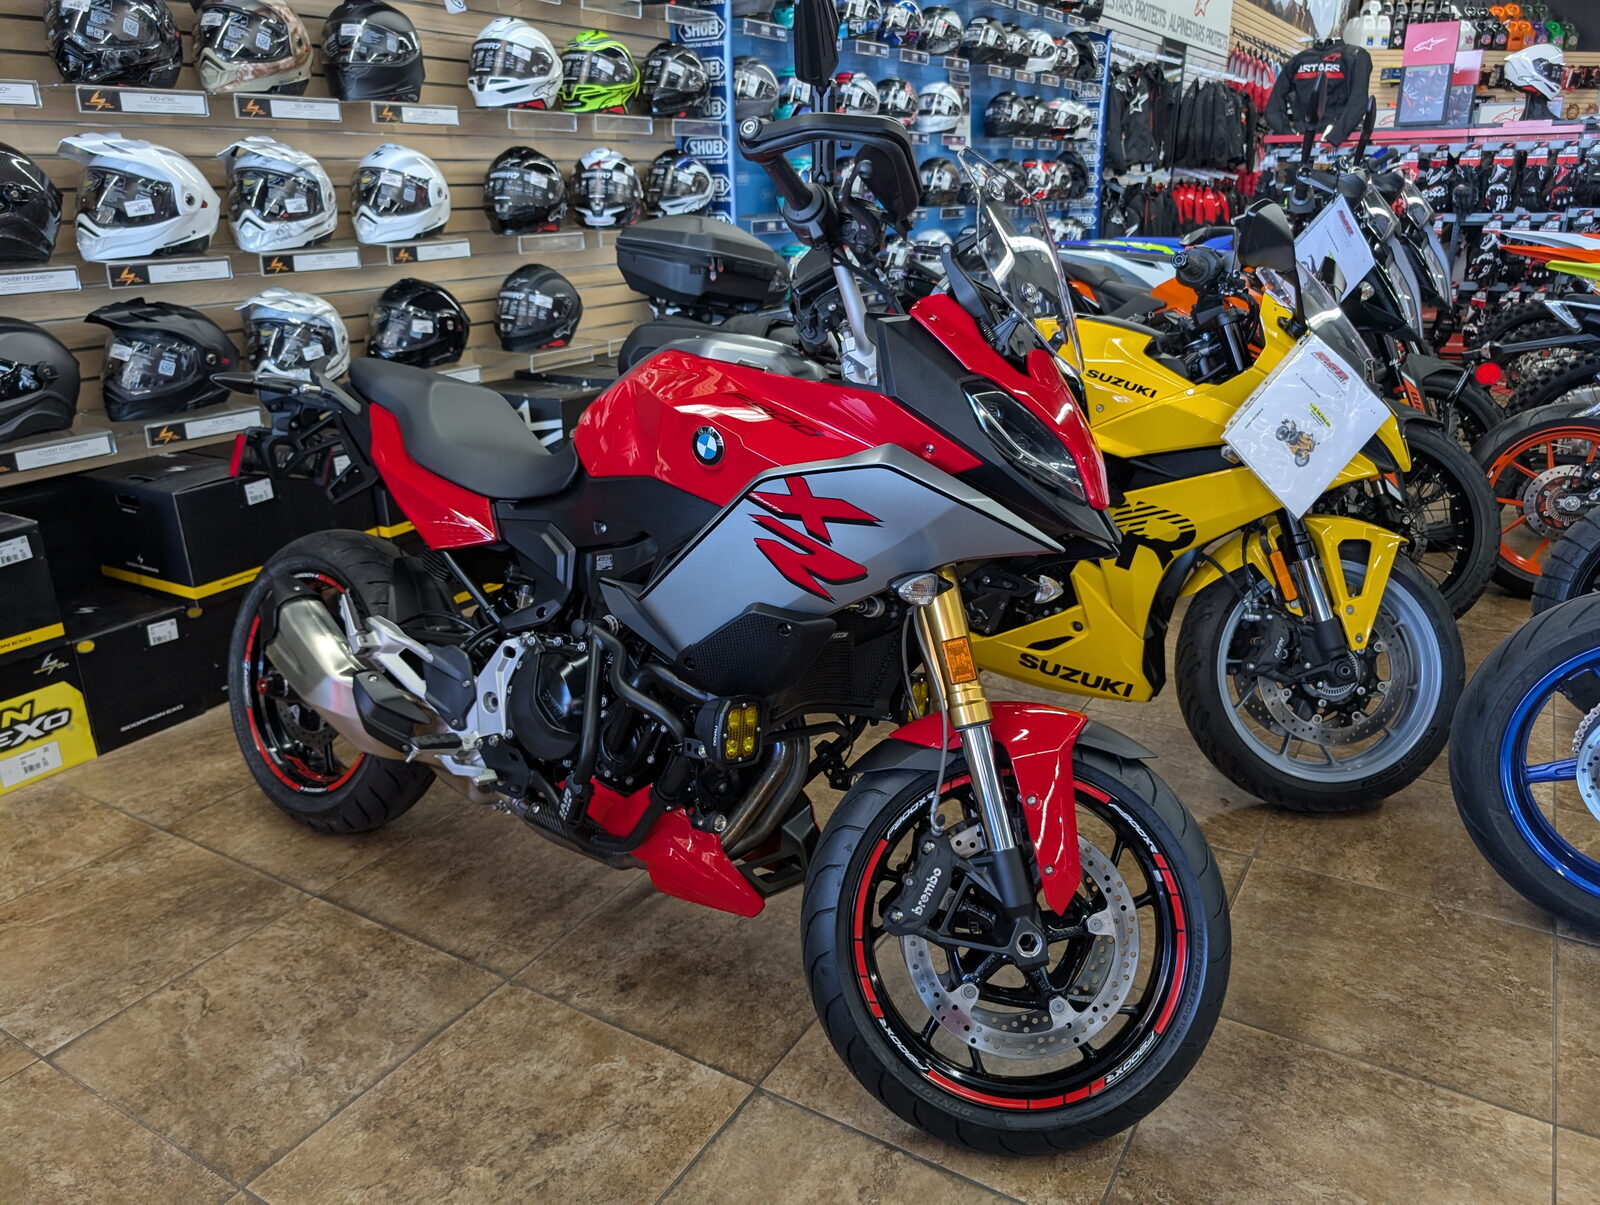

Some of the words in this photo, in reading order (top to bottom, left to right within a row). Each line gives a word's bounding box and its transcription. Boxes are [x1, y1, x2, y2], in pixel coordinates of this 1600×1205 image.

[684, 19, 719, 38] SHOEI
[1134, 3, 1167, 29] PROTECTS
[1168, 12, 1206, 41] ALPINESTARS
[1205, 27, 1228, 51] PROTECTS
[689, 140, 724, 156] SHOEI
[1086, 369, 1158, 399] SUZUKI
[1018, 653, 1134, 698] SUZUKI
[0, 709, 70, 748] EXO
[887, 790, 936, 840] F900XR
[1108, 803, 1159, 854] F900XR
[911, 867, 942, 917] brembo
[878, 1018, 930, 1070] F900XR
[1105, 1030, 1155, 1083] F900XR
